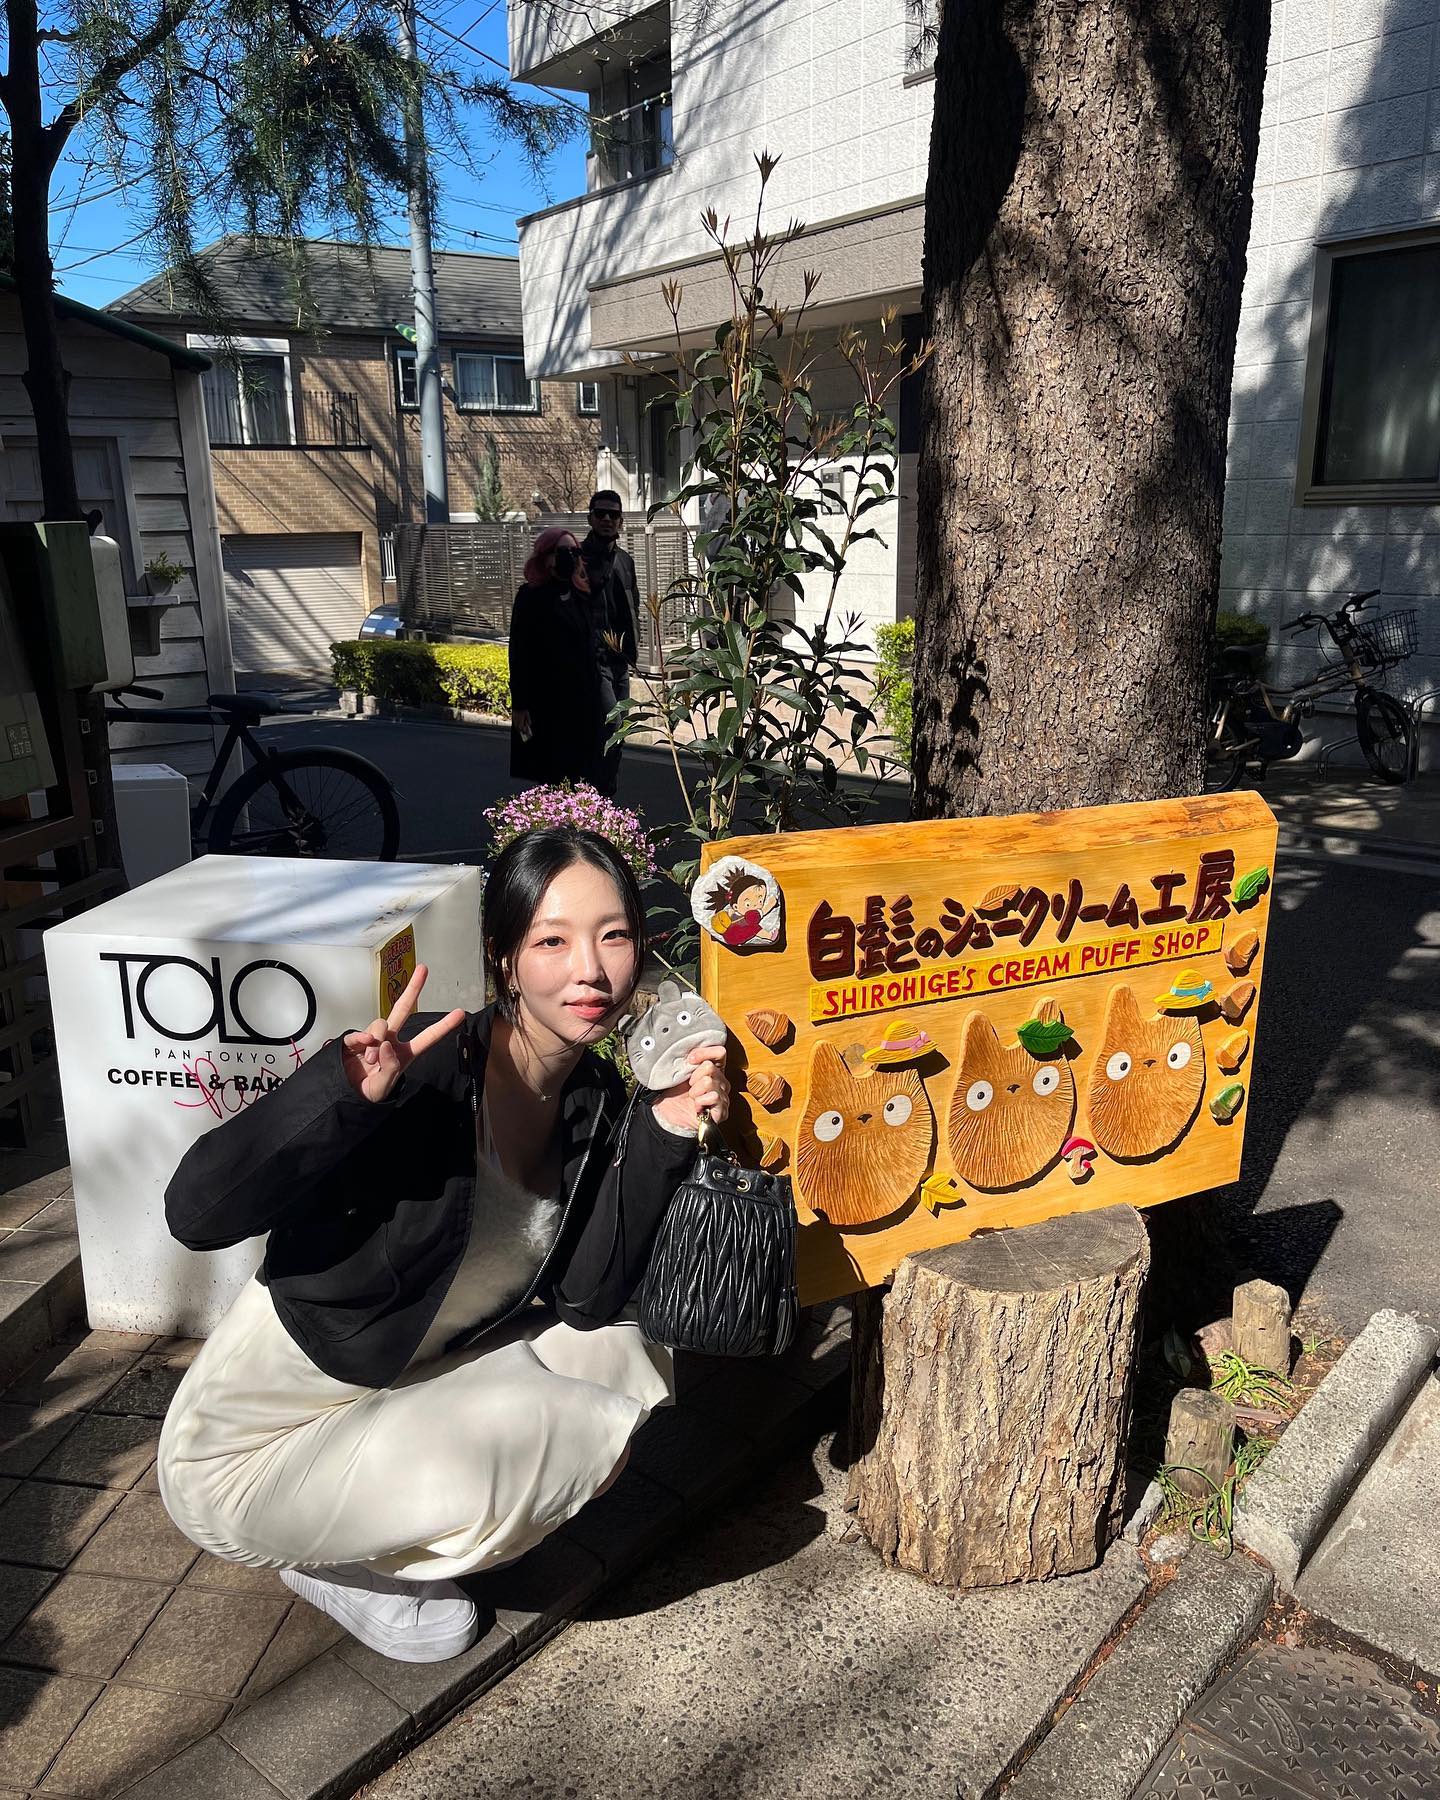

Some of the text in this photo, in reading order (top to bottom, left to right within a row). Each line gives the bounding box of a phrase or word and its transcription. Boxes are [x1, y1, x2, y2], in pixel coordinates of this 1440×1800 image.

[807, 848, 1235, 982] 白髭のシュークリーム工房
[100, 952, 317, 1046] TOLO
[822, 927, 1210, 1016] SHIROHIGE'S CREAM PUFF SHOP
[107, 1068, 288, 1093] COFFEE & BAK
[154, 1048, 276, 1065] PAN TOKYO
